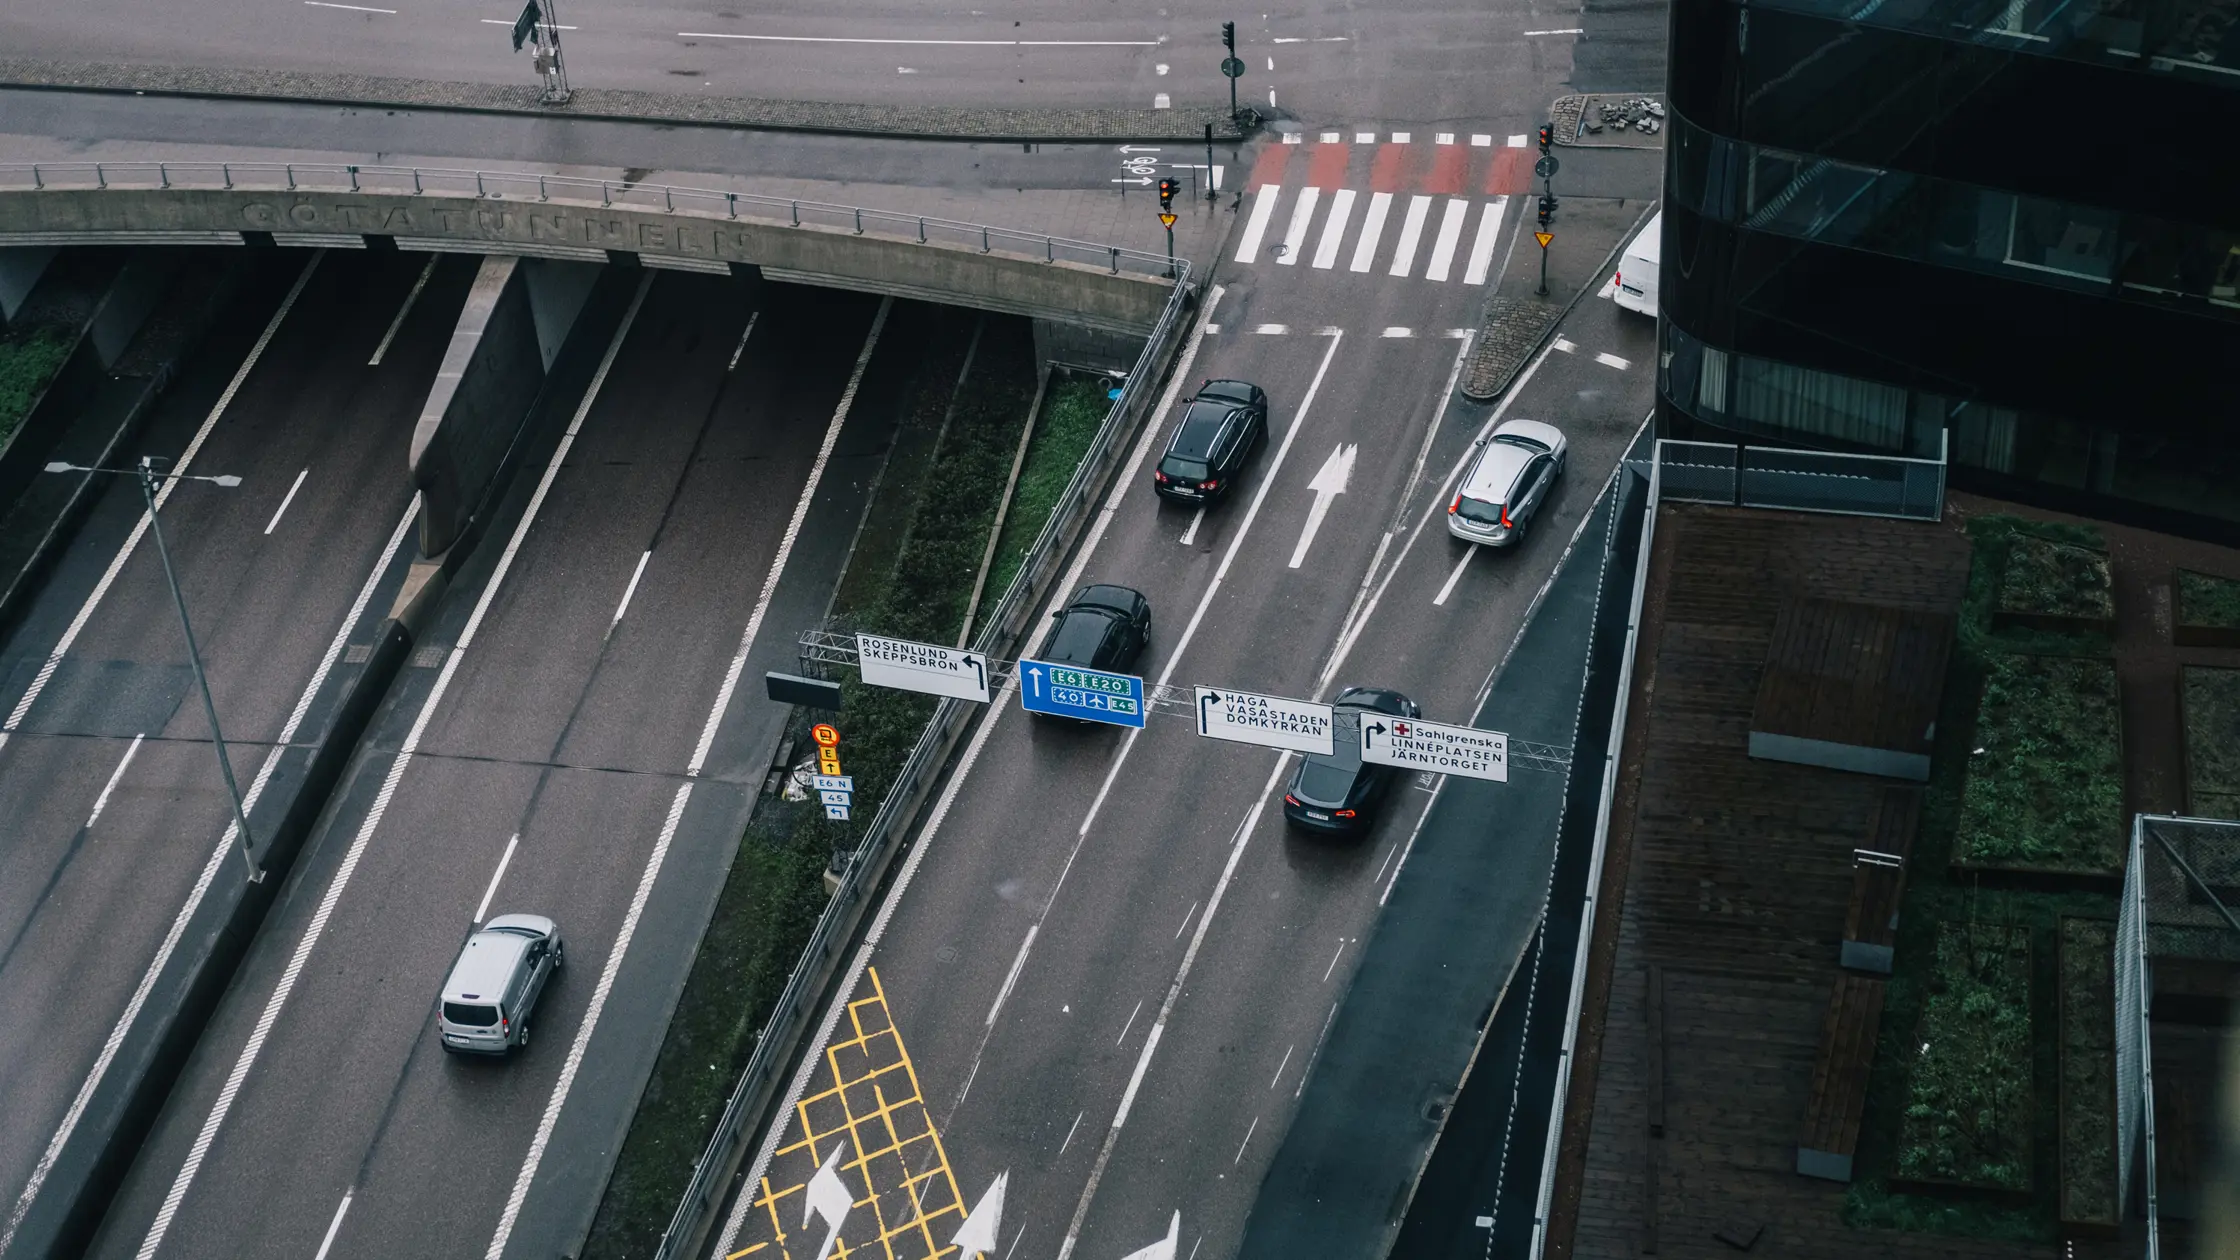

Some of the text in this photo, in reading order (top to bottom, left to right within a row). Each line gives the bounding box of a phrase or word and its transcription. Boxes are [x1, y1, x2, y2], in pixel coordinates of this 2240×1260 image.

[240, 196, 753, 257] GÖTATUNNELN
[862, 638, 948, 660] ROSENLUND
[863, 648, 958, 671] SKEPPSBRON
[1058, 673, 1122, 690] E6 E20
[1058, 691, 1134, 710] 40 E45
[1225, 693, 1268, 708] HAGA
[1226, 703, 1328, 727] VASASTADEN
[1227, 713, 1321, 736] DOMKYRKAN
[1416, 728, 1502, 749] Sahlgrenska
[825, 749, 833, 758] E
[1391, 737, 1502, 763] LINNÉPLATSEN
[1391, 748, 1488, 772] JÄRNTORGET
[819, 779, 846, 788] E6 N
[828, 794, 843, 802] 45
